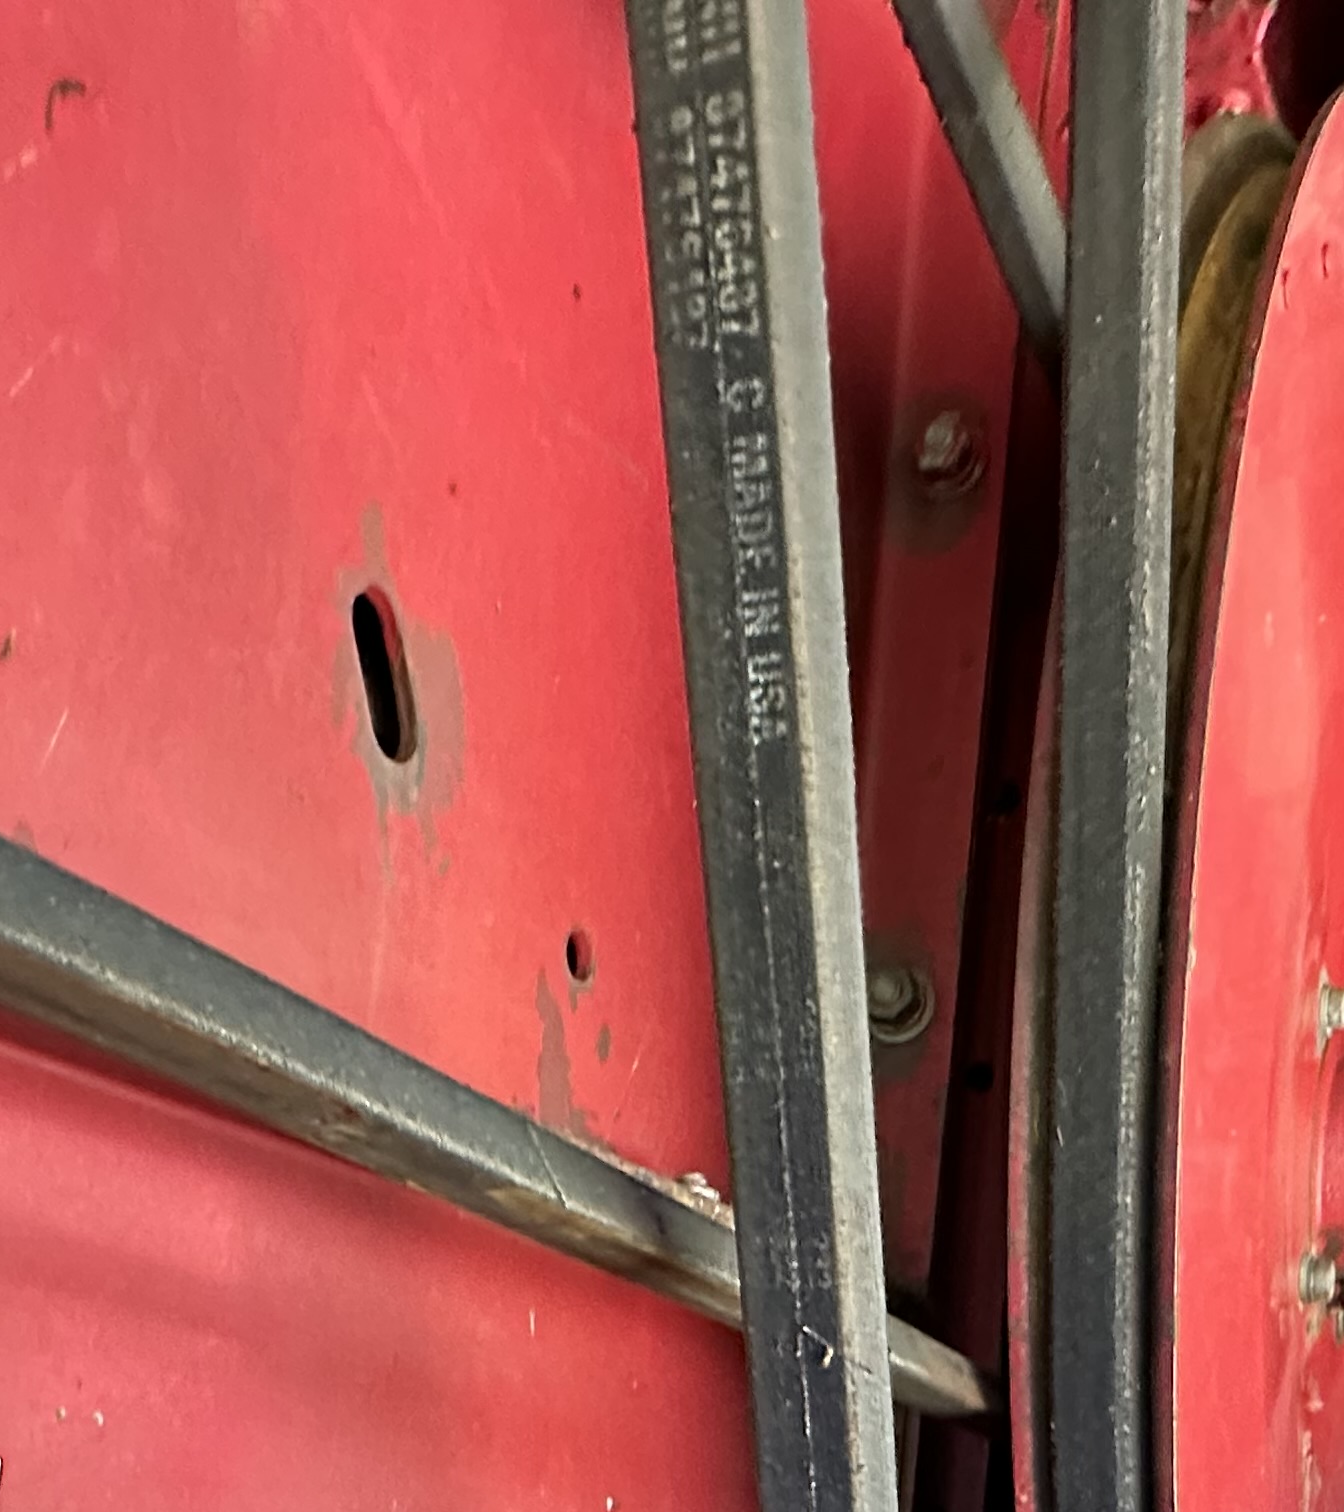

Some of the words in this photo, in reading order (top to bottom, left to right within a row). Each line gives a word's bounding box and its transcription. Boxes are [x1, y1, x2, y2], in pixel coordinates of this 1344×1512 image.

[729, 432, 777, 573] MADE
[741, 586, 781, 637] IN
[747, 652, 787, 746] USA
